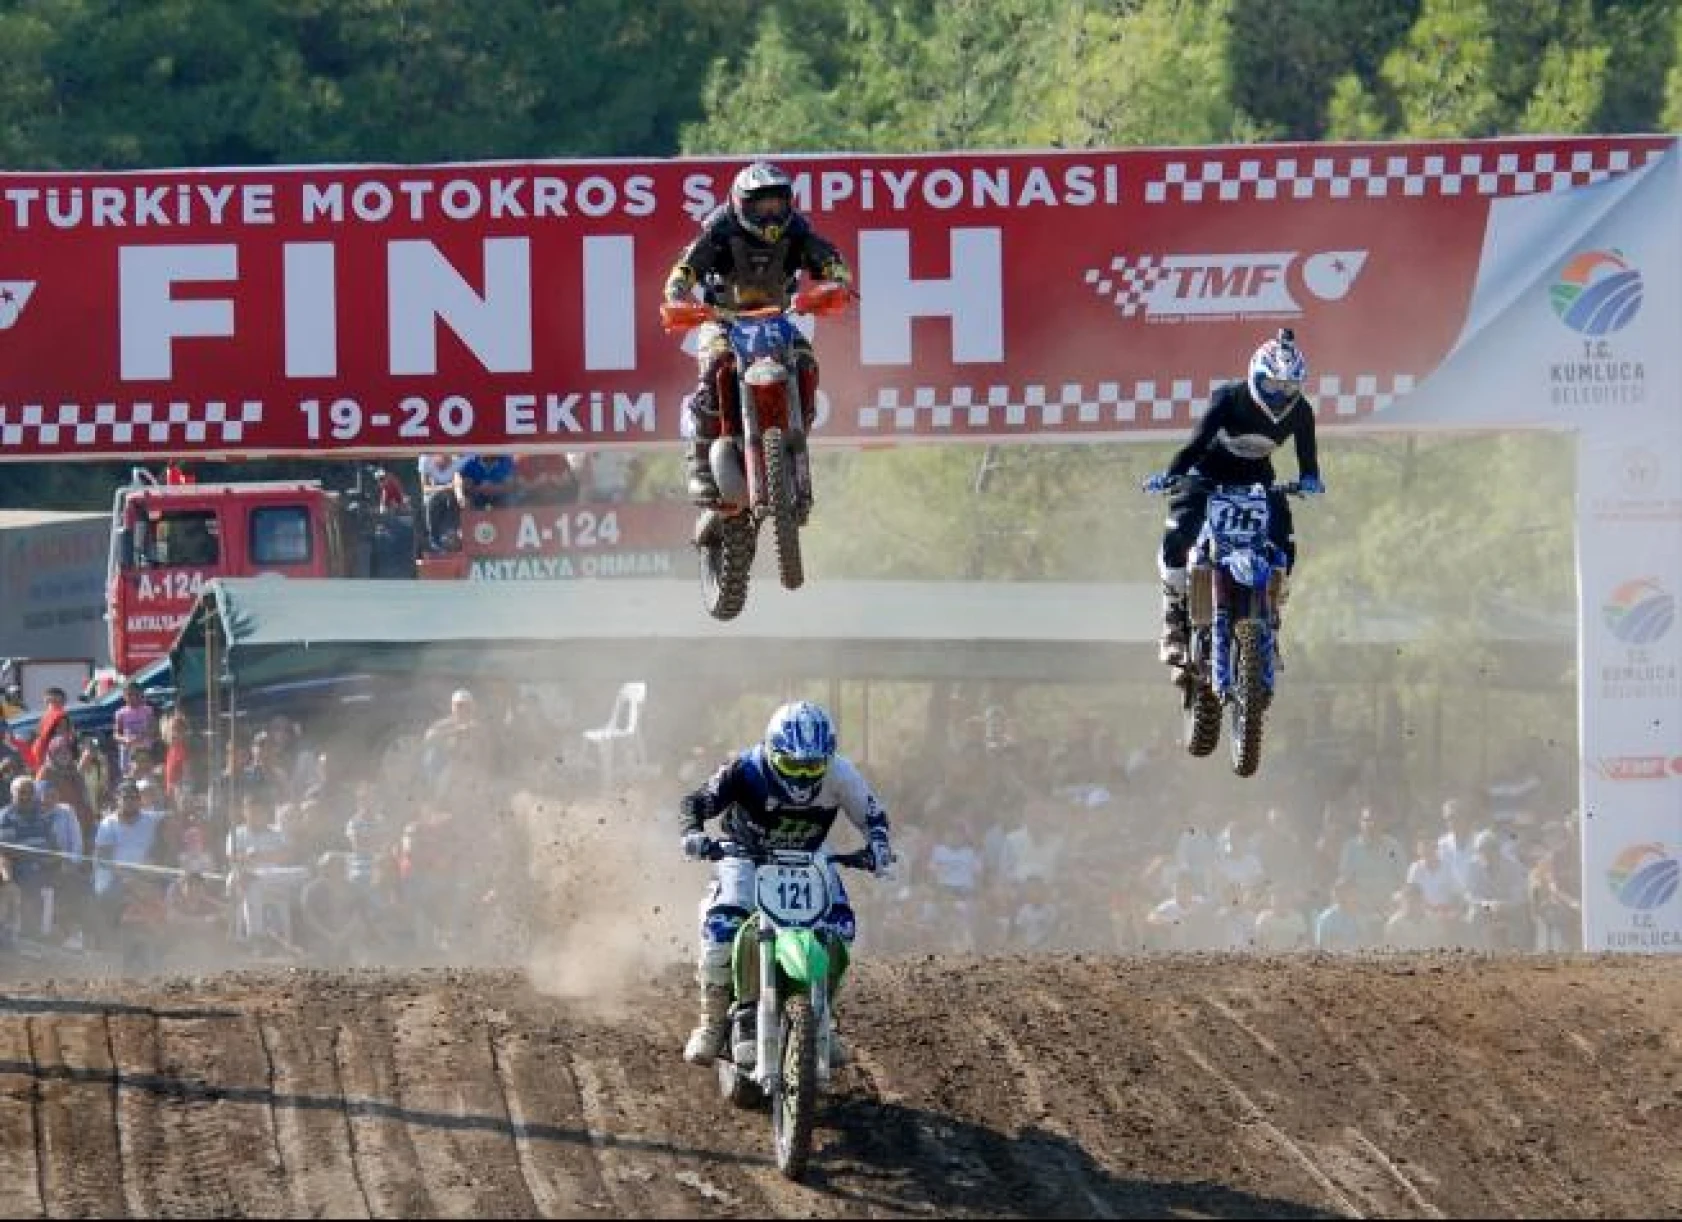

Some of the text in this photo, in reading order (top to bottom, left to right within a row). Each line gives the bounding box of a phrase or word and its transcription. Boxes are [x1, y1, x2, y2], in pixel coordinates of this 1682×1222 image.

[6, 166, 1118, 228] TÜRKİYE MOTOKROS ŞPİYONASI
[1173, 263, 1282, 299] TMF
[118, 227, 1004, 381] FINIH
[1551, 361, 1644, 382] KUMLUCA
[300, 395, 475, 439] 19-20
[505, 392, 655, 437] EKİM
[516, 510, 620, 549] A-124
[469, 552, 671, 581] ANTALYA ORMAN
[138, 571, 203, 601] A-124
[777, 882, 813, 909] 121
